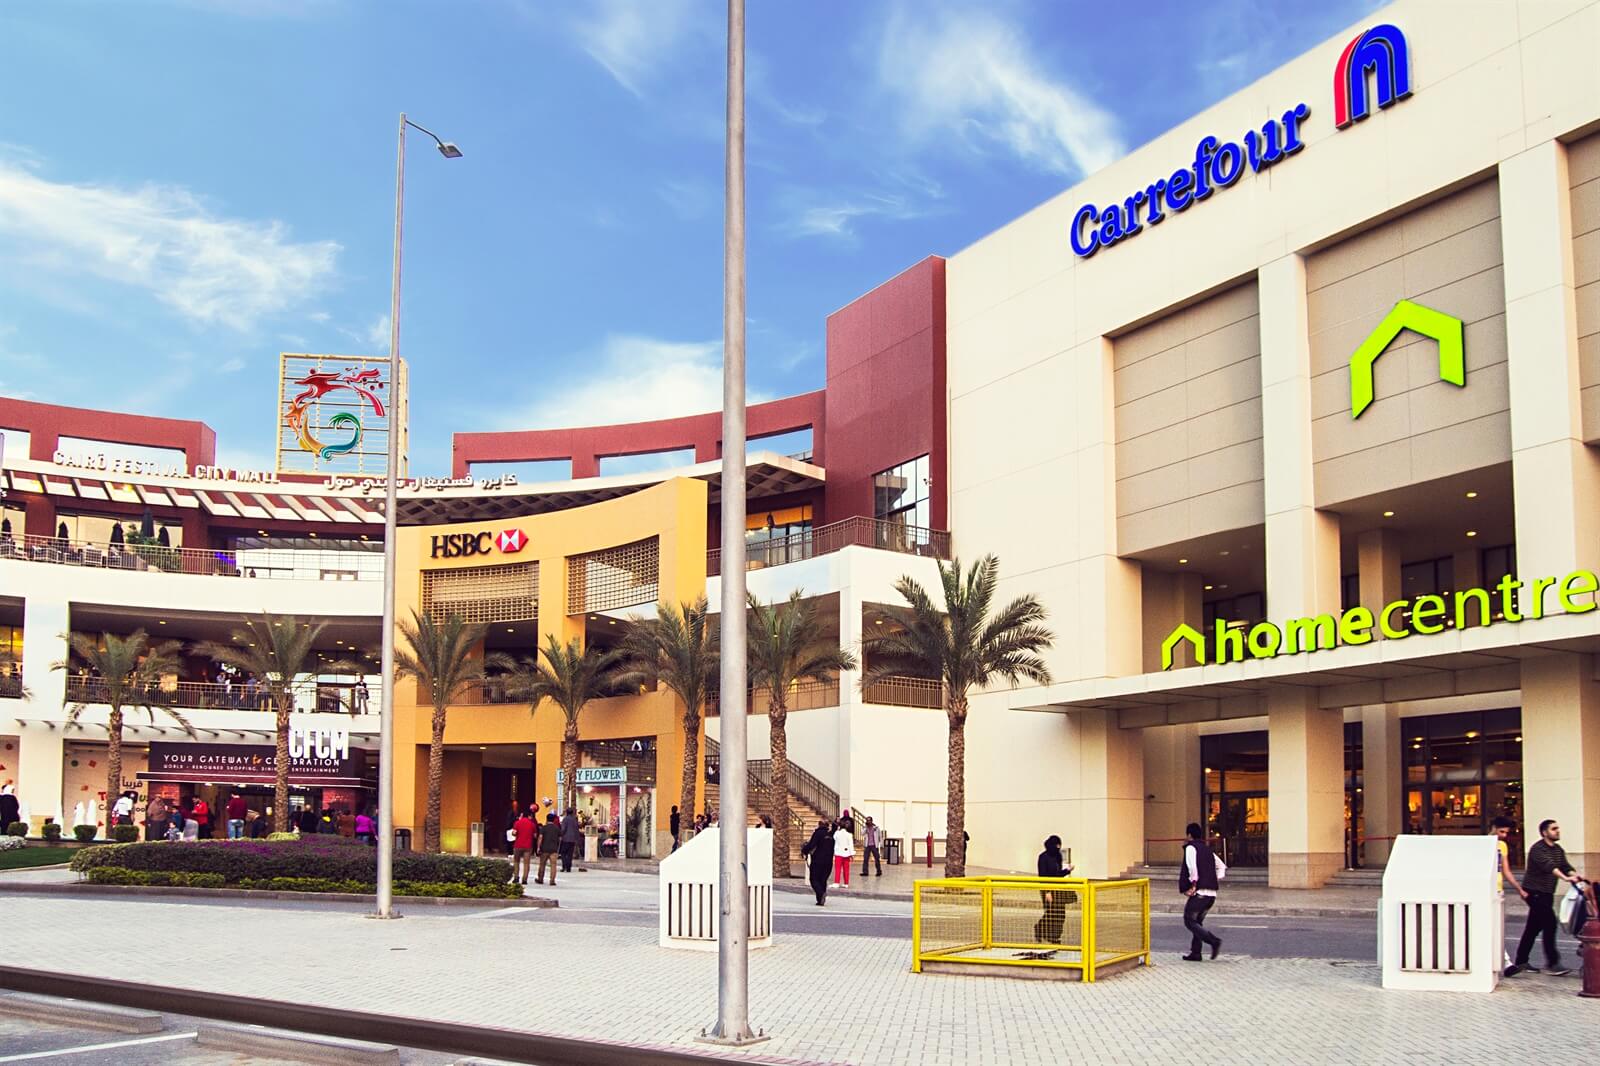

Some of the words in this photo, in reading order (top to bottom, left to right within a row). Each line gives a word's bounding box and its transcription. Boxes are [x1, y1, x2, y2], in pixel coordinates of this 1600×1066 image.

[1070, 103, 1310, 257] Carrefour
[53, 450, 106, 471] CAIRO
[195, 464, 231, 481] CITY
[237, 469, 280, 484] MALL
[323, 474, 355, 491] مول
[430, 531, 492, 559] HSBC
[1215, 570, 1598, 664] homecentre
[289, 727, 349, 760] CFCM
[163, 754, 193, 763] YOUR
[199, 755, 250, 764] GATEWAY
[265, 756, 340, 766] CEEBRATION
[585, 769, 621, 781] FLOWER
